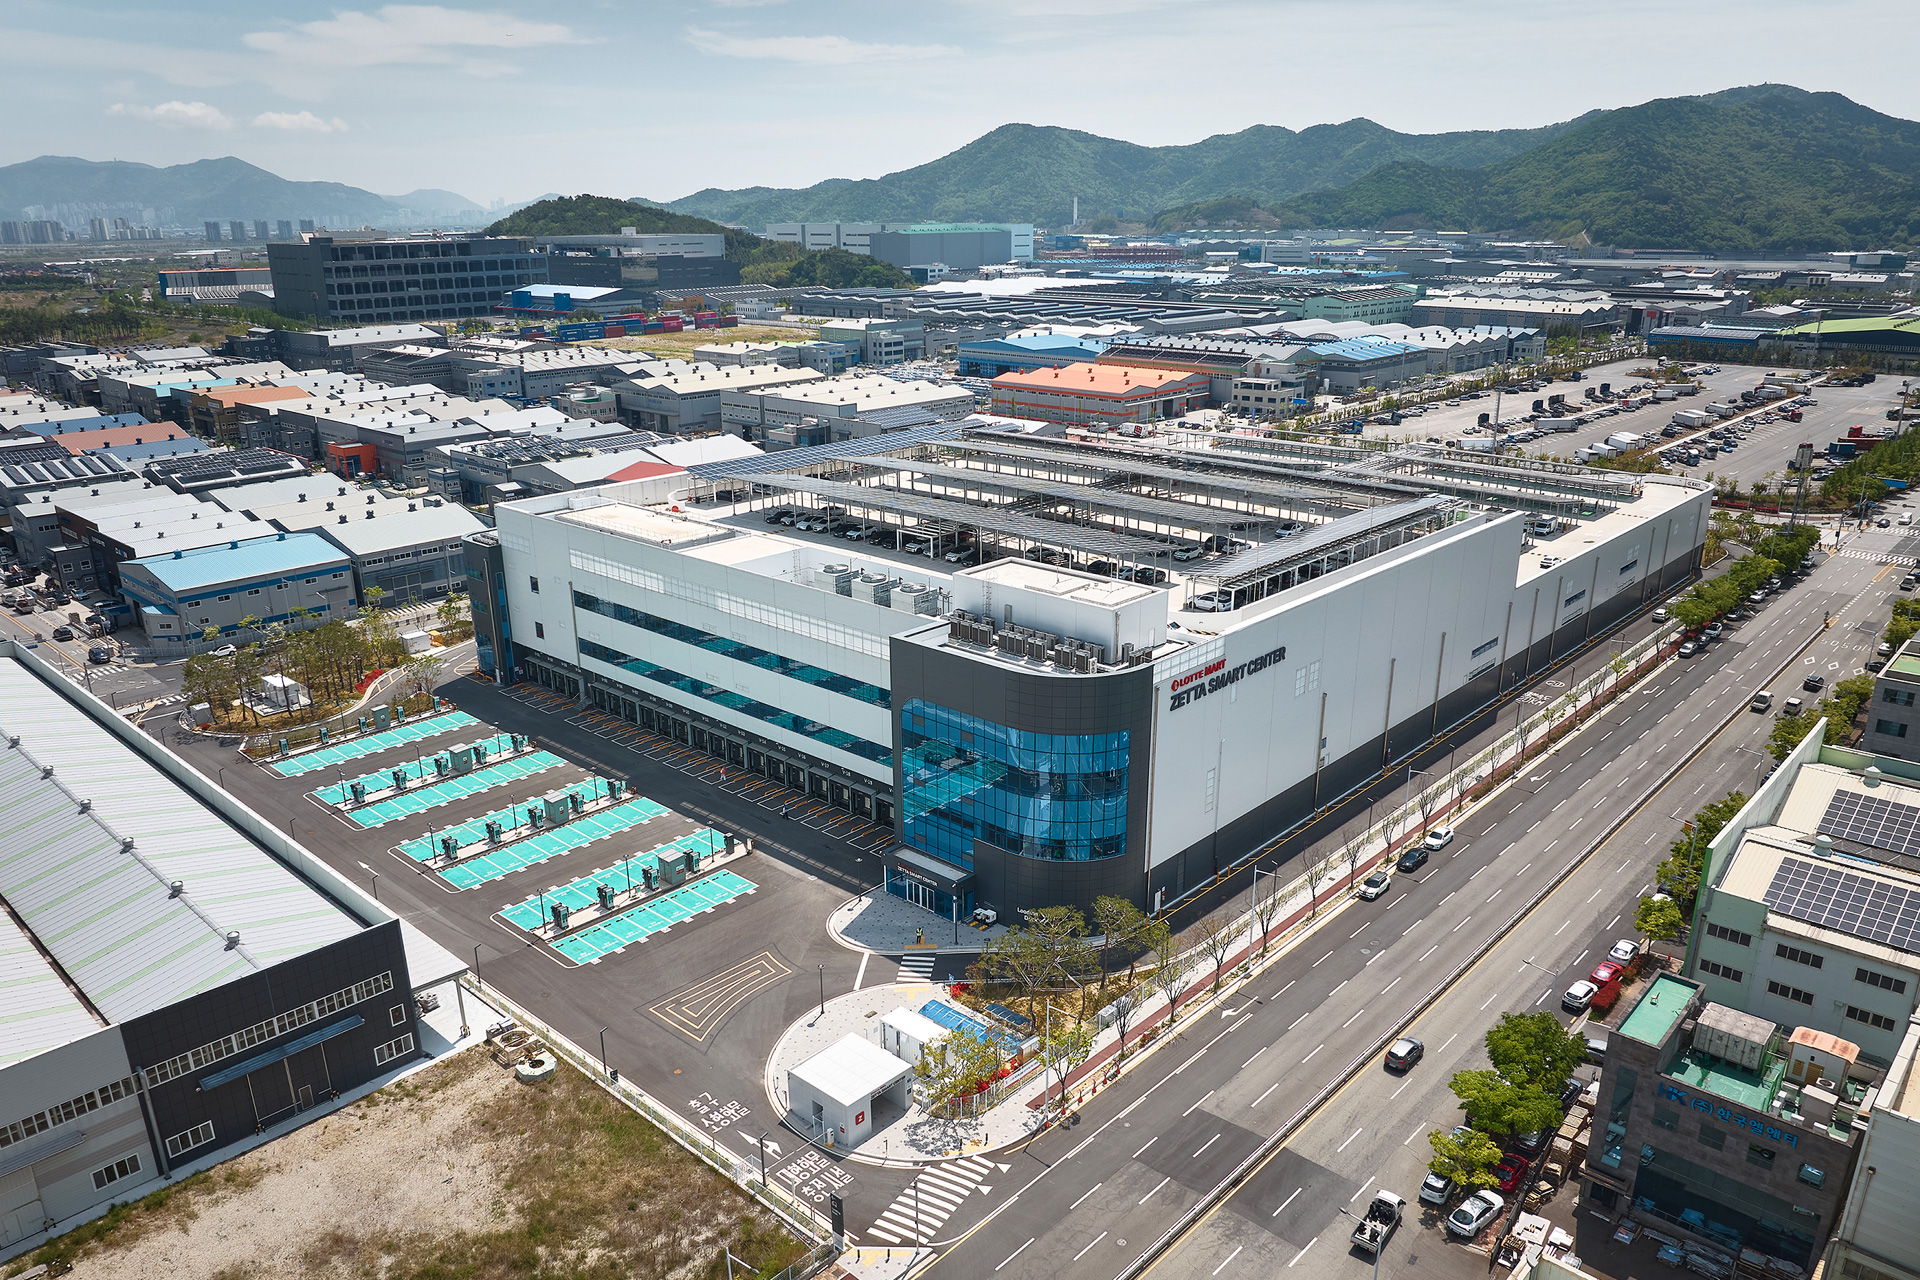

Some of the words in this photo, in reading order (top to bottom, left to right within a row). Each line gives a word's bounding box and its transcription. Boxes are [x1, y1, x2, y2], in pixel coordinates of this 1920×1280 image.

[1170, 682, 1207, 712] ZETTA
[1208, 663, 1248, 694] SMART
[1248, 646, 1287, 675] CENTER
[1180, 668, 1204, 687] LOTTE
[1204, 658, 1226, 676] MART
[688, 1092, 720, 1114] 출구
[700, 1100, 752, 1134] 소형화물
[801, 1165, 855, 1202] 충전시설
